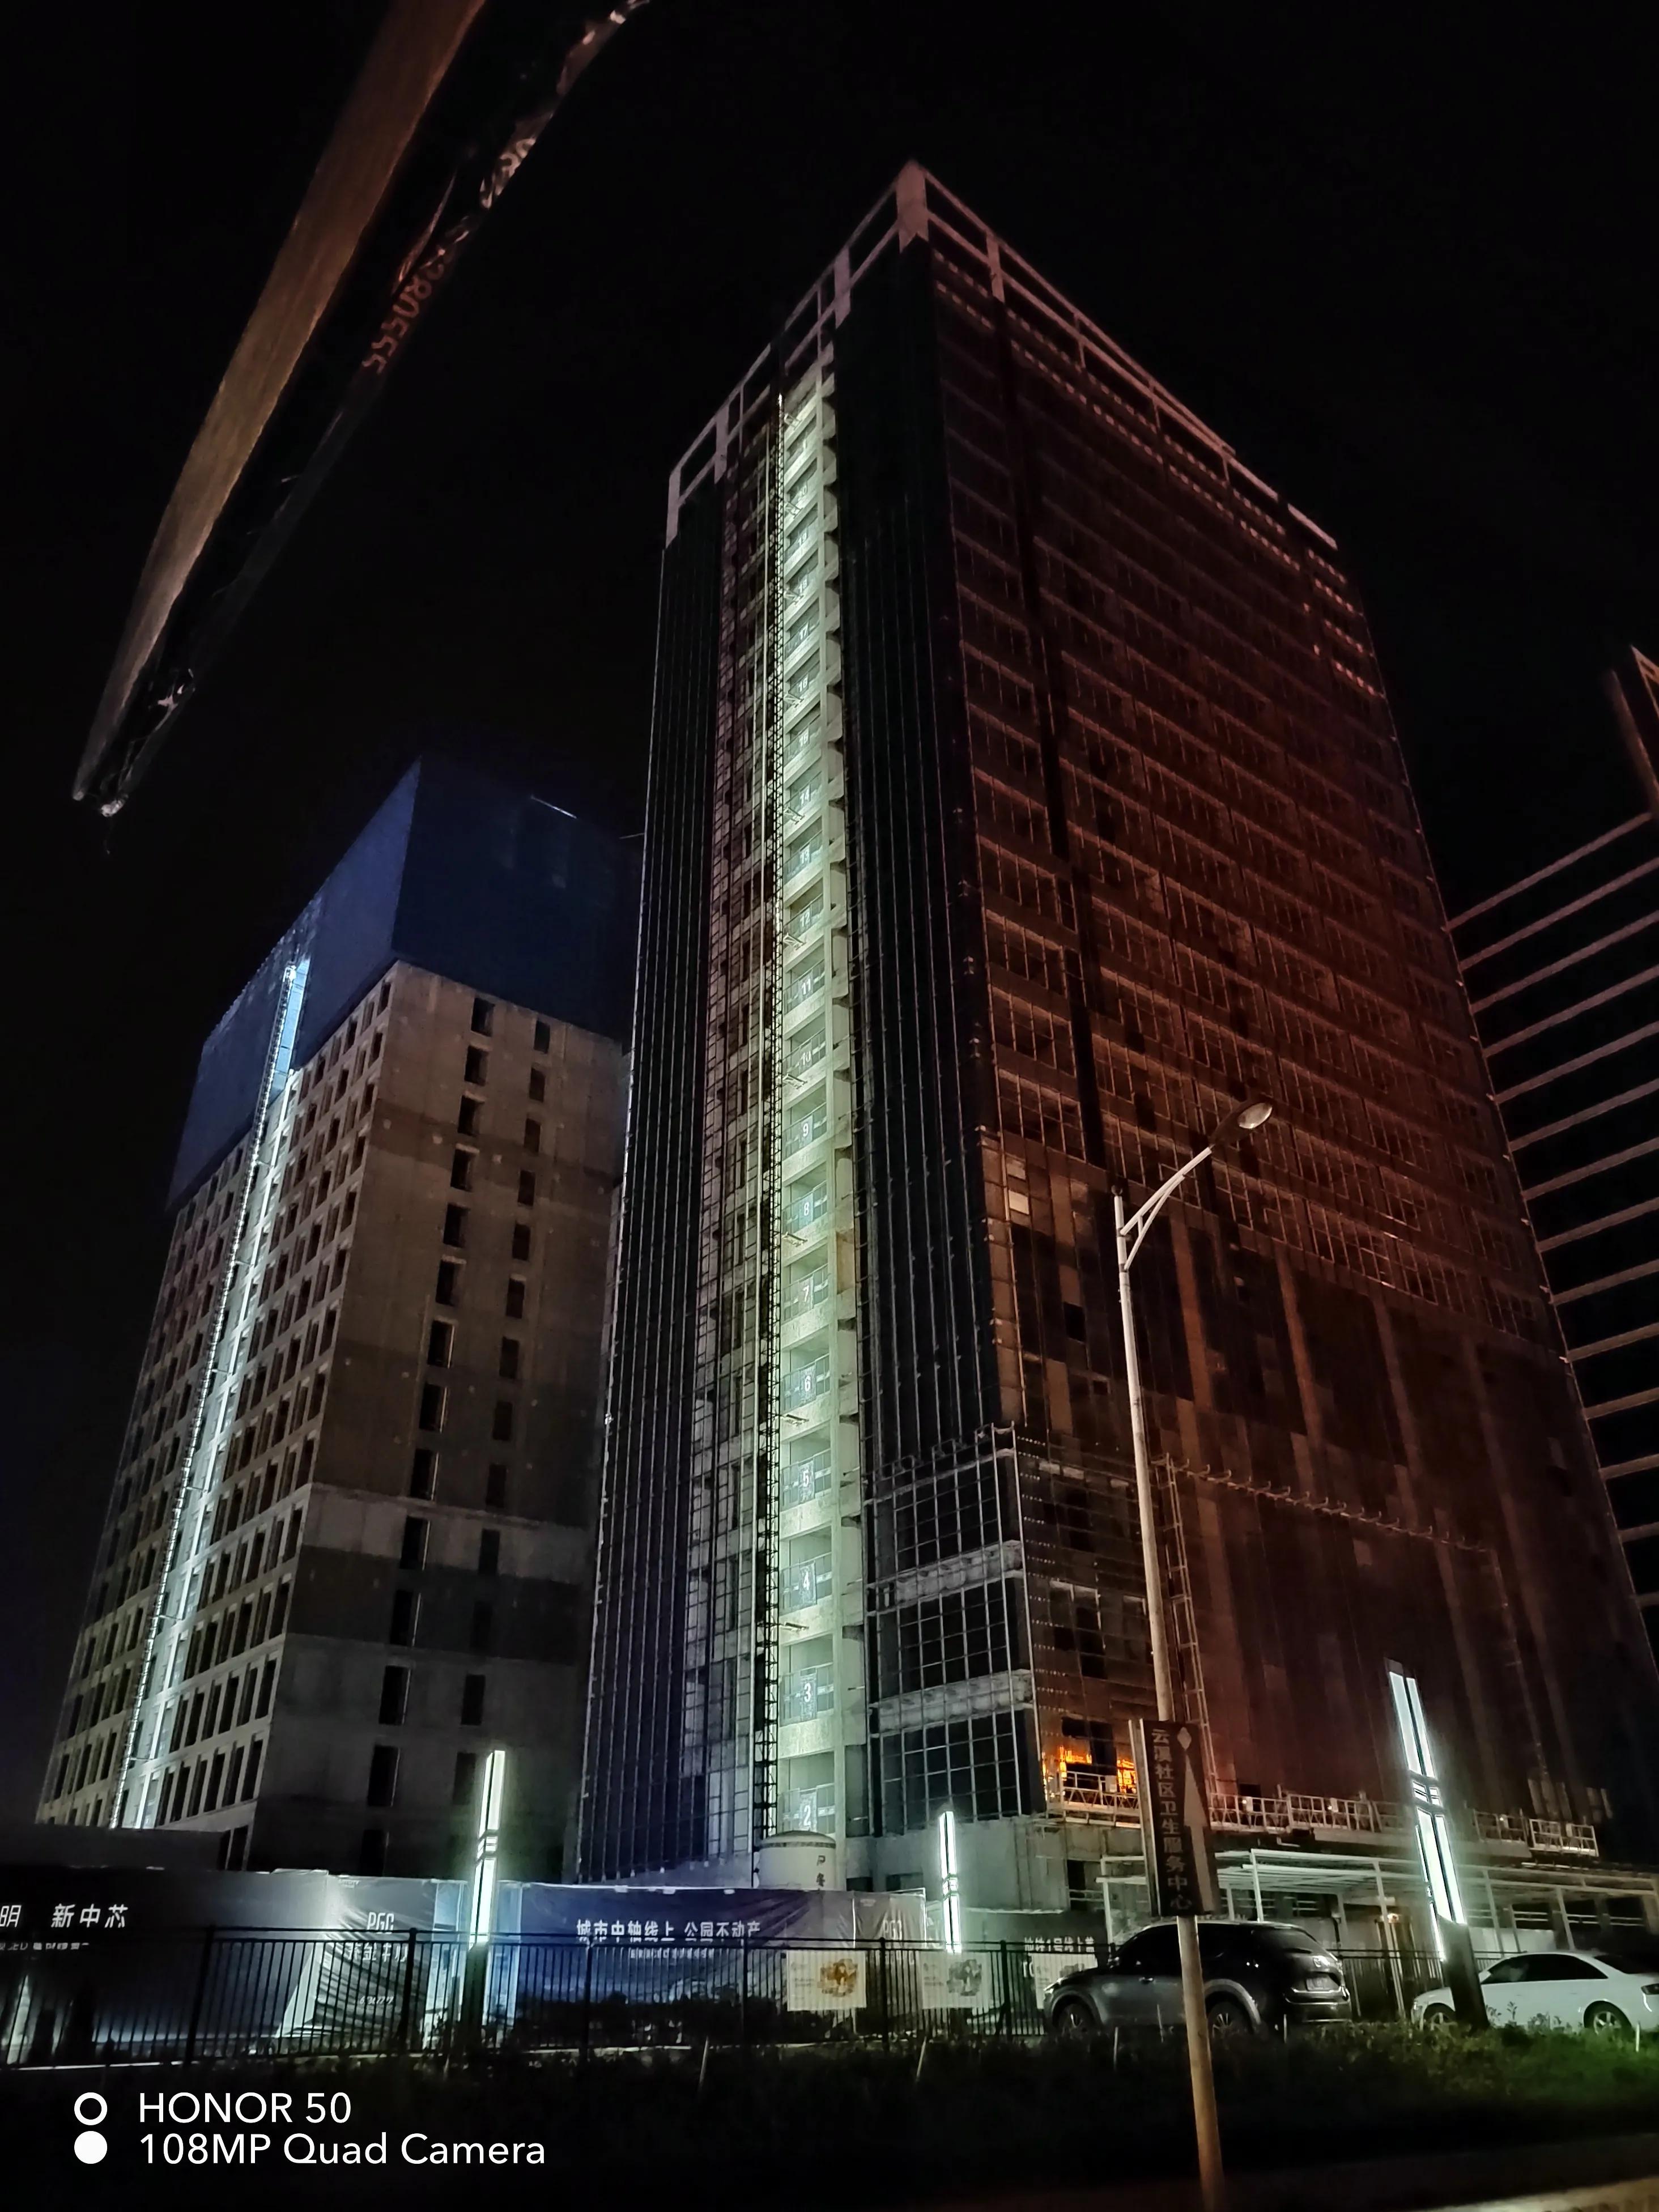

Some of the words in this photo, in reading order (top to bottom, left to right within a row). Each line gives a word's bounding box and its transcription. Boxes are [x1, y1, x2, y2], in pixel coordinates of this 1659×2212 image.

[799, 911, 810, 928] 12
[801, 978, 811, 996] 11
[802, 1050, 811, 1066] 10
[802, 1121, 809, 1137] 9
[803, 1201, 810, 1216] 8
[803, 1284, 810, 1303] 7
[804, 1375, 811, 1392] 6
[802, 1468, 810, 1487] 5
[803, 1571, 810, 1591] 4
[804, 1682, 811, 1703] 3
[803, 1805, 811, 1827] 2
[0, 1904, 22, 1928] 明
[50, 1903, 129, 1928] 新中芯
[576, 1919, 675, 1942] 城市中轴线上
[684, 1920, 761, 1943] 公园不动产
